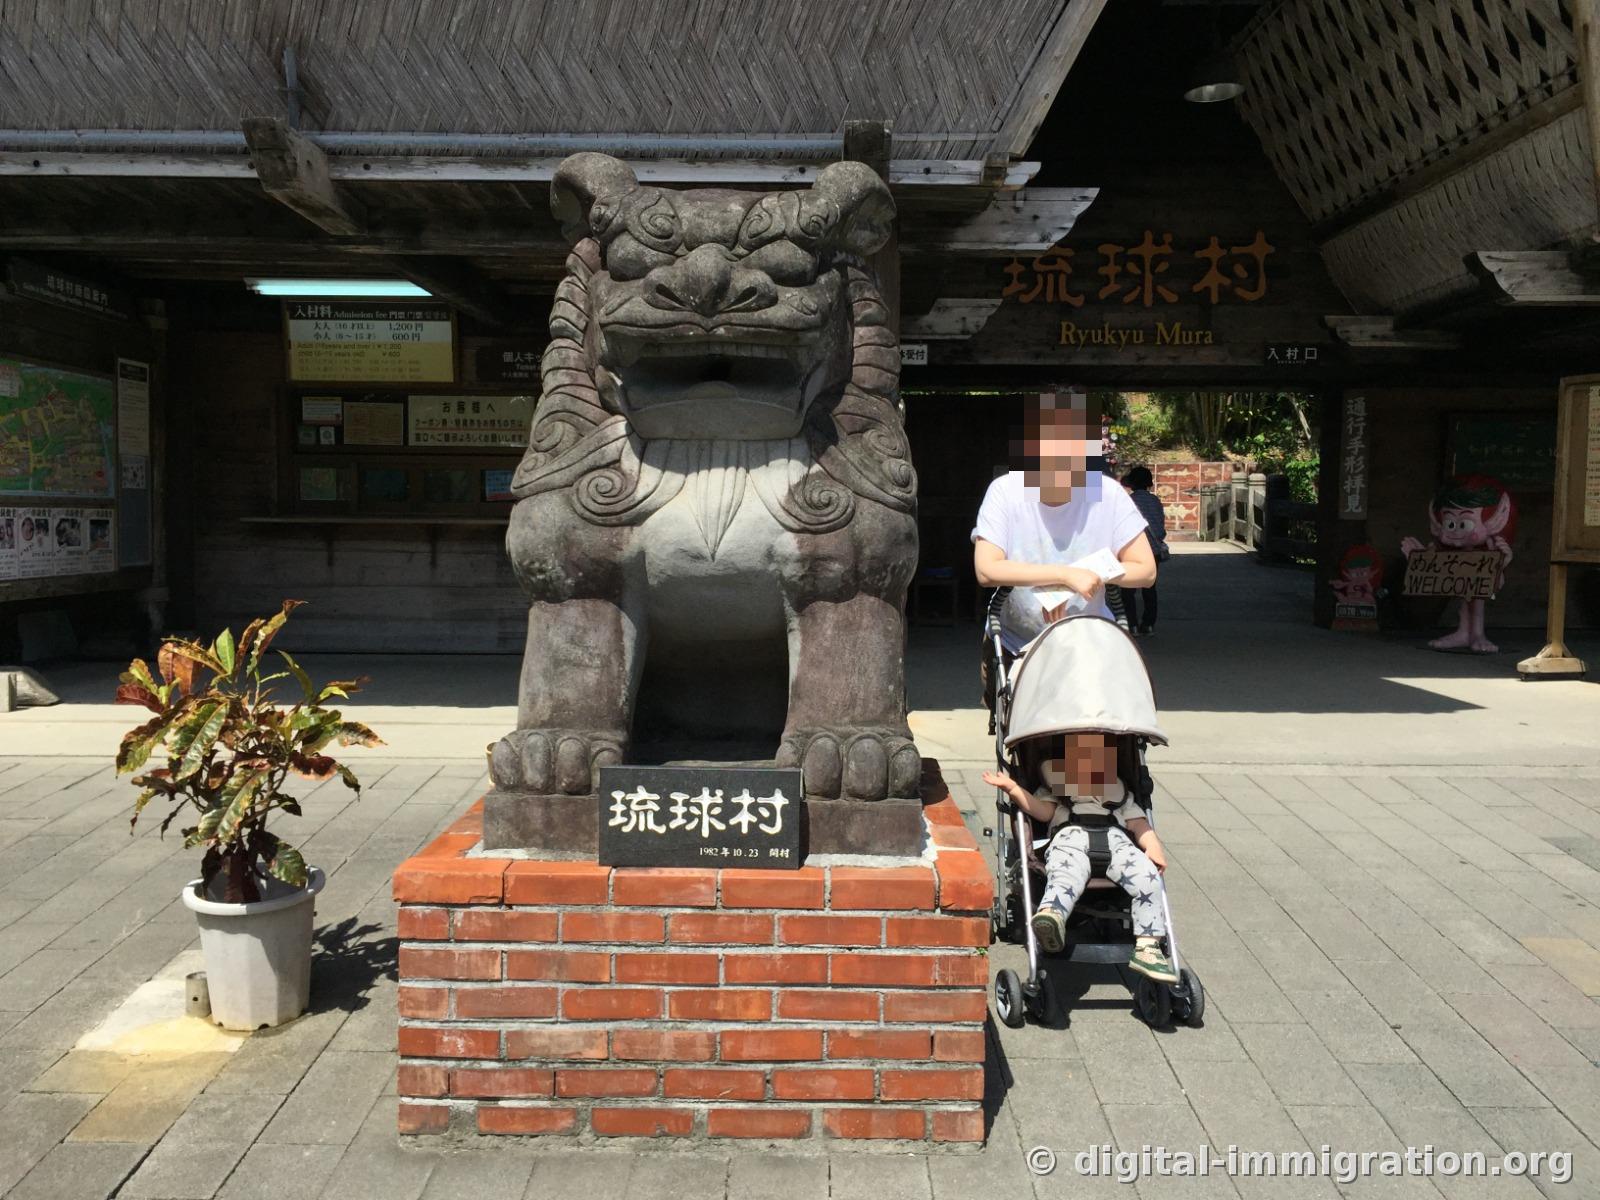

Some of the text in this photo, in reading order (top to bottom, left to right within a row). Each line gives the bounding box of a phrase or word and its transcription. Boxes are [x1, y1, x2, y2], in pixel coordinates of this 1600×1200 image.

[1002, 230, 1275, 307] 琉球村
[295, 304, 332, 318] 入村料
[1059, 320, 1214, 351] Ryukyu Mura
[1267, 347, 1318, 360] 入村口
[1343, 396, 1369, 513] 通行手形拝見
[1409, 575, 1490, 596] WELCOME
[608, 785, 790, 838] 琉球村
